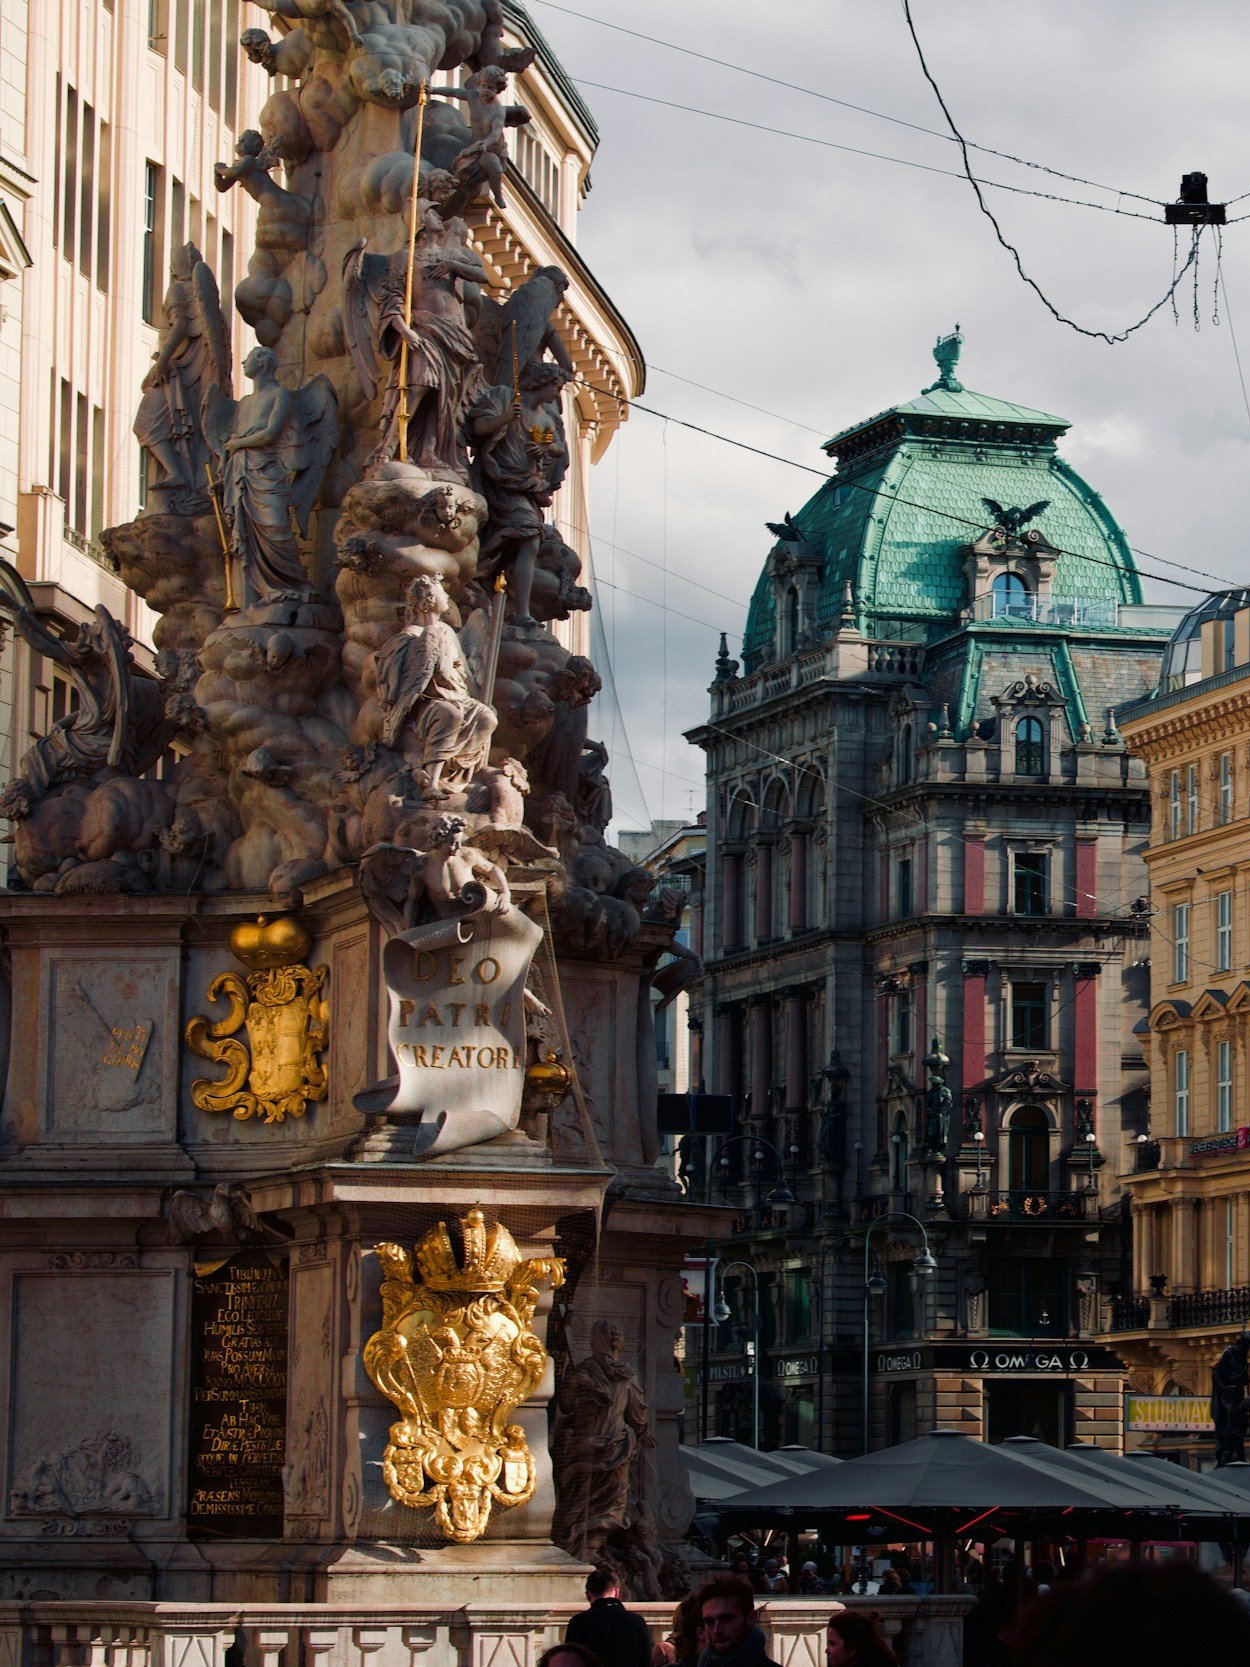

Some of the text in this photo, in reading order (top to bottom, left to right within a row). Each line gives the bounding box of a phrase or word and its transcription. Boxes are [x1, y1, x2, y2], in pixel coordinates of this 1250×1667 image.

[411, 950, 502, 985] DEO
[398, 1000, 511, 1027] PATRI
[396, 1044, 520, 1070] CREATORI
[786, 1359, 809, 1376] OMEGA
[887, 1354, 912, 1372] OMEGA
[1135, 1402, 1212, 1422] STURMAY
